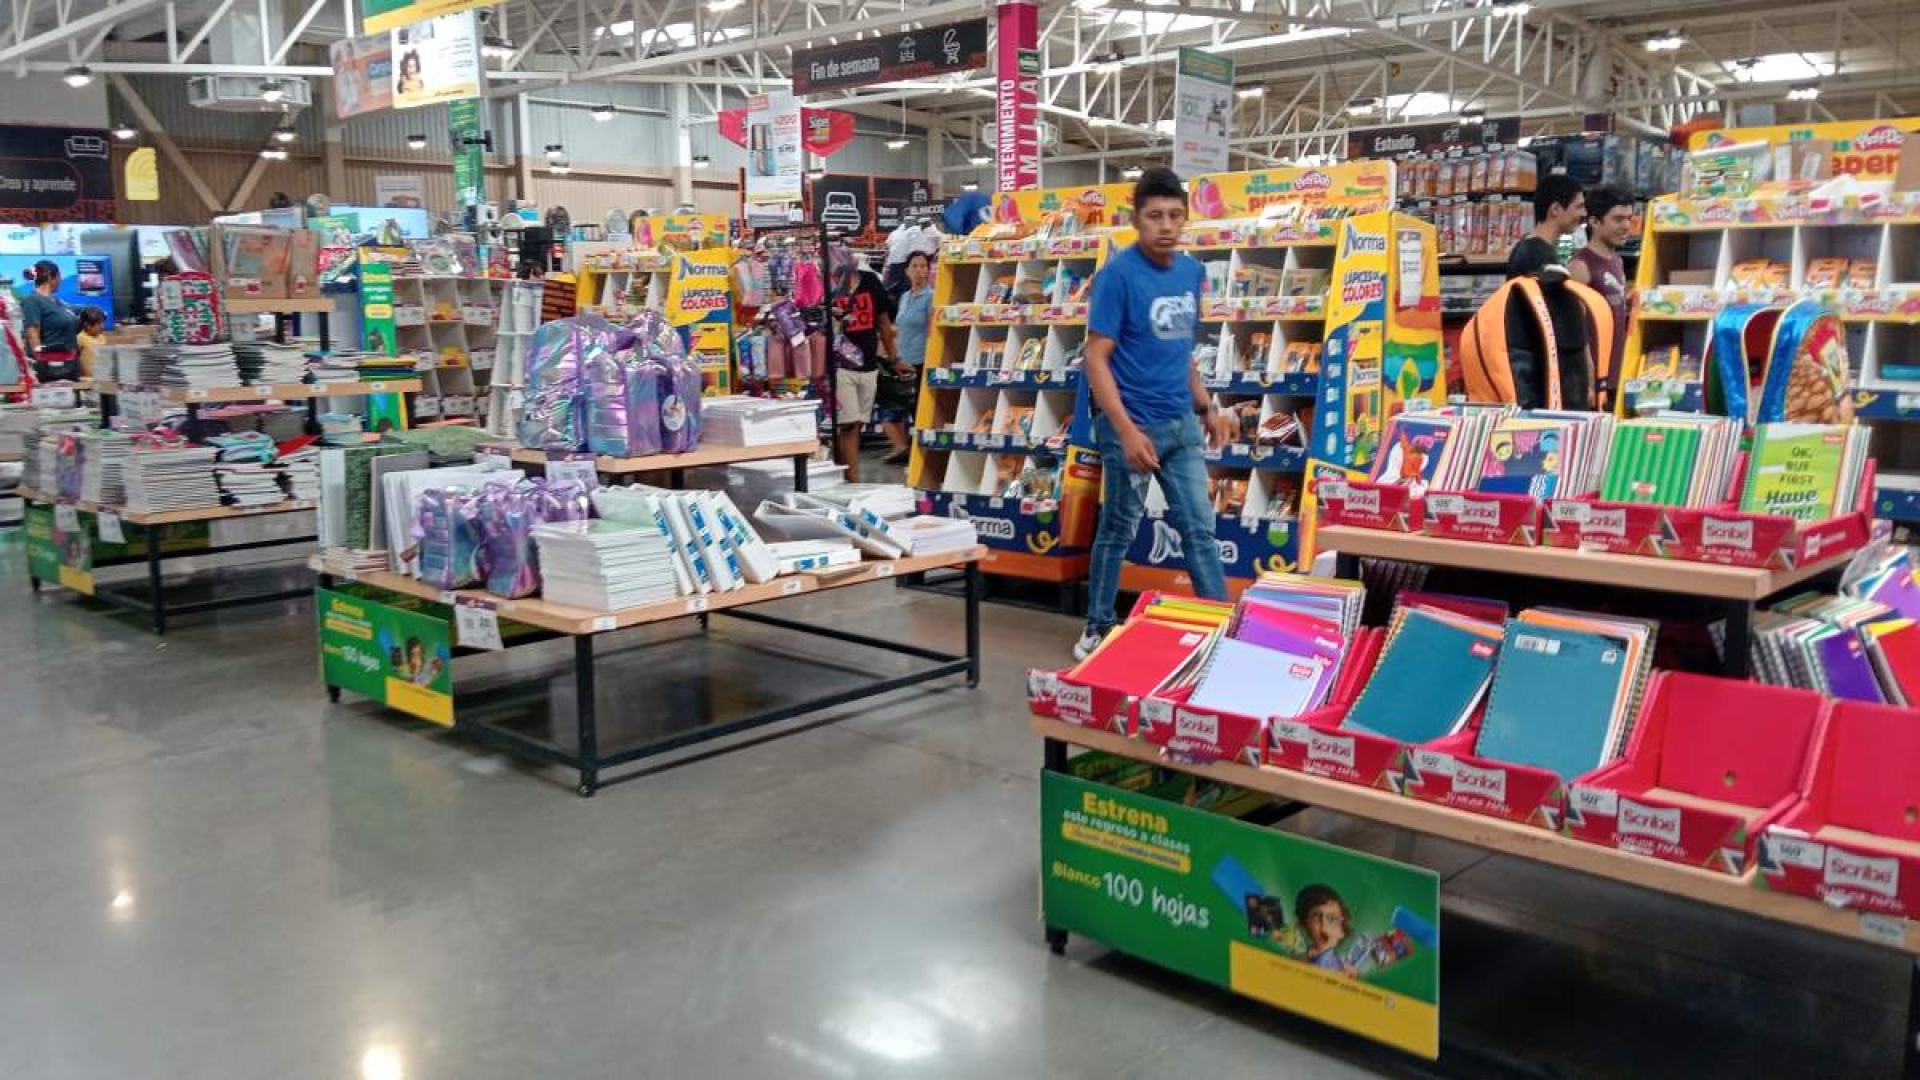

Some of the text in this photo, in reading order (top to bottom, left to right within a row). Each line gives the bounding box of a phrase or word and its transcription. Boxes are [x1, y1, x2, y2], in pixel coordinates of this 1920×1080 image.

[810, 56, 881, 81] Fin de semana
[1341, 222, 1386, 259] Norma
[678, 256, 729, 281] Norma
[681, 296, 727, 311] COLORES
[1342, 281, 1383, 303] COLORES
[1765, 490, 1818, 505] Have
[1707, 522, 1750, 541] Scribe
[1180, 716, 1215, 735] Scribe
[1311, 738, 1351, 758] Scribe
[1456, 769, 1501, 791] Scribe
[1082, 791, 1169, 834] Estrena
[1623, 807, 1676, 832] Scribe
[1063, 809, 1089, 825] este
[1090, 817, 1138, 840] regreso
[1139, 832, 1148, 843] a
[1151, 834, 1192, 855] clases
[1831, 857, 1893, 884] Scribe
[1052, 861, 1210, 929] Blanco 100 hojas
